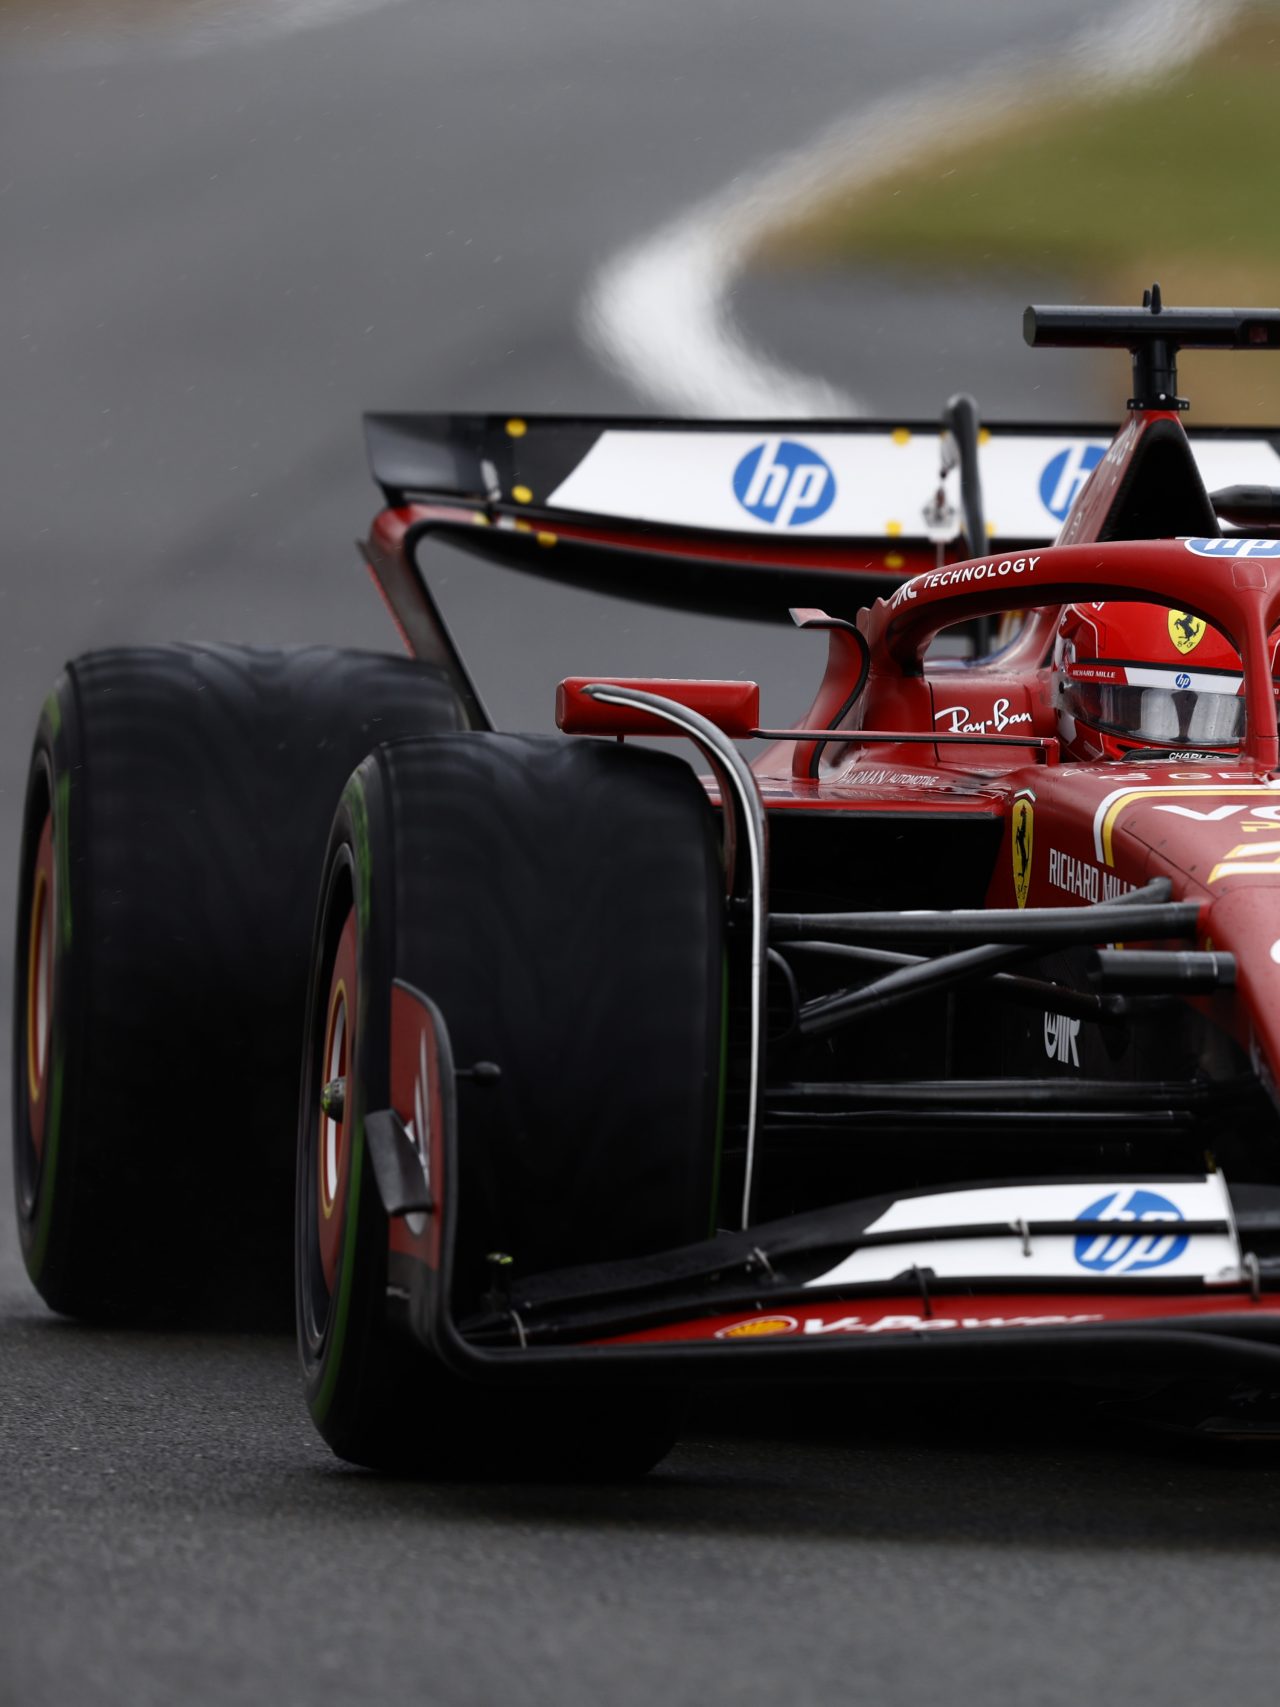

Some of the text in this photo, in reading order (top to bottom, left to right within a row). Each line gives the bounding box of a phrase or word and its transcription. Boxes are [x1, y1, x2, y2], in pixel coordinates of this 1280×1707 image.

[742, 439, 830, 526] hp
[1047, 444, 1095, 515] h
[923, 556, 1041, 589] TECHNOLOGY
[1095, 671, 1116, 679] MILLE
[1176, 674, 1191, 688] hp
[1048, 847, 1100, 905] RICHARD
[1079, 1189, 1182, 1273] hp
